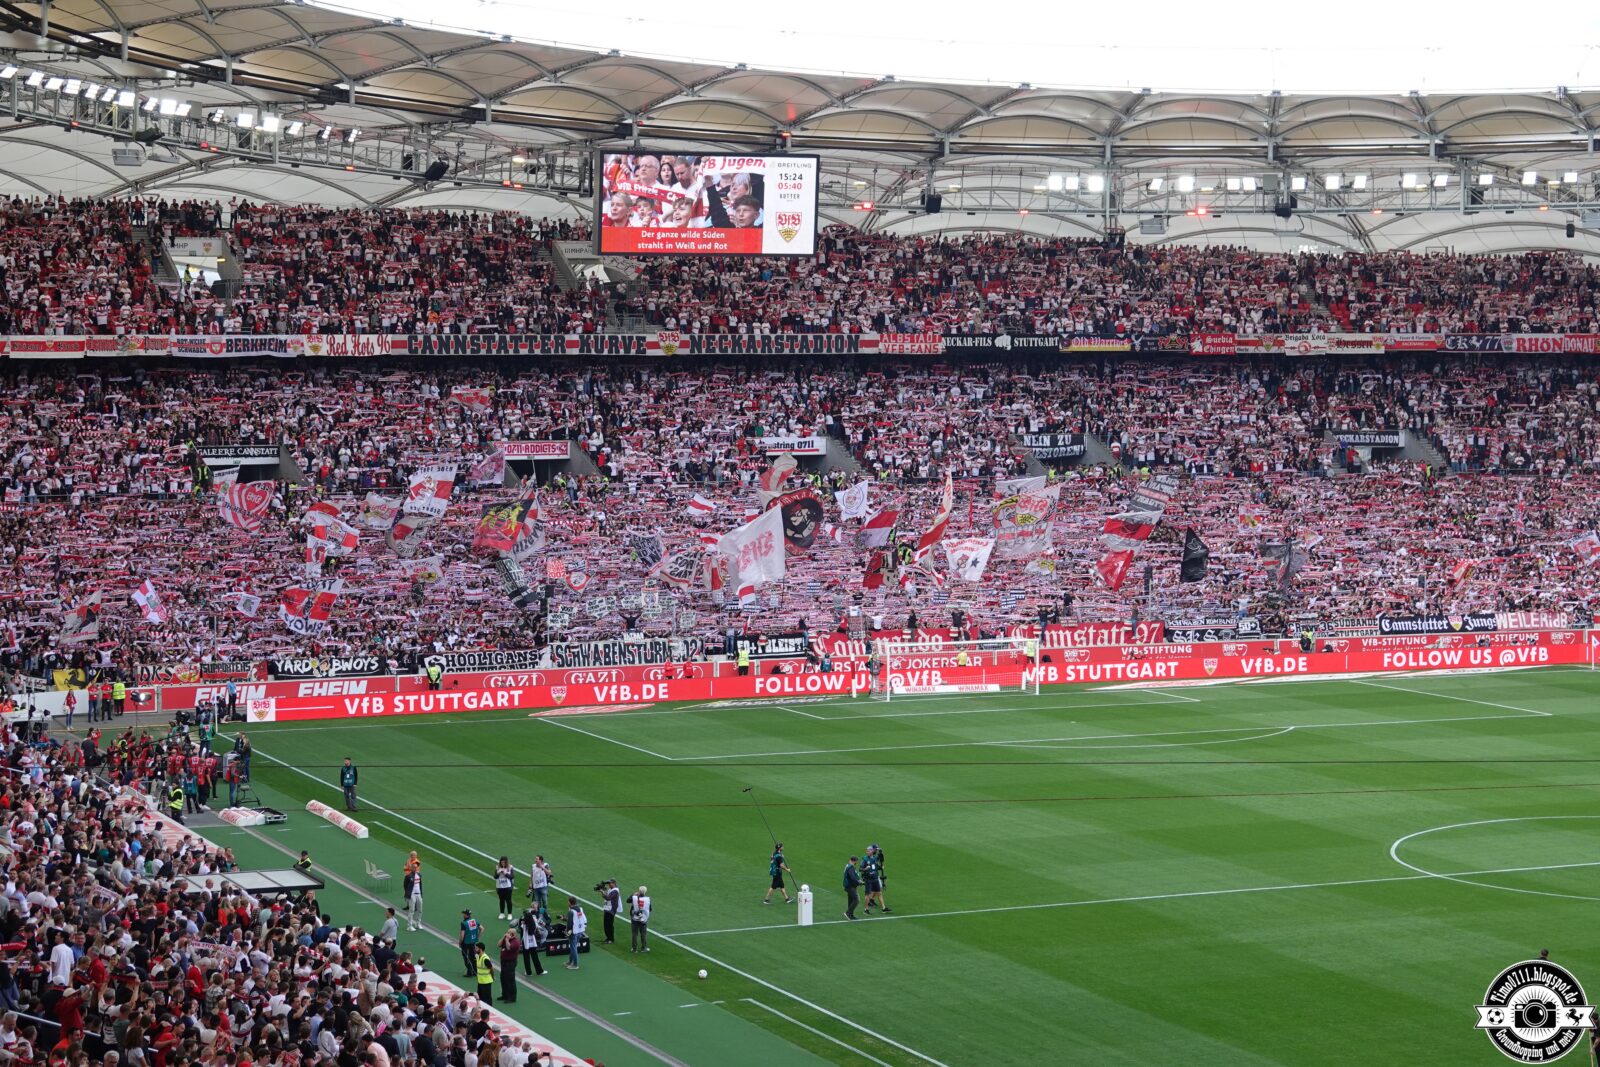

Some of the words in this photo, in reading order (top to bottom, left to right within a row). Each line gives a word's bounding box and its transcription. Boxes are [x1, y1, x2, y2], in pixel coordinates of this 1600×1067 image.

[779, 173, 803, 181] 15:24
[778, 182, 802, 190] 05:40
[641, 230, 654, 239] Der
[656, 232, 678, 240] ganze
[681, 230, 700, 239] wilde
[702, 230, 725, 239] Süden
[637, 241, 663, 250] strahlt
[665, 242, 673, 250] in
[675, 241, 695, 250] Weiß
[698, 241, 712, 250] und
[714, 242, 727, 250] Rot
[225, 337, 288, 353] BERKHEIM
[326, 334, 348, 356] Red
[352, 335, 374, 356] Hots
[377, 334, 391, 354] 96
[407, 334, 566, 355] CANNSTATTER
[579, 334, 647, 355] KURVE
[690, 334, 860, 354] NECKARSTADION
[881, 334, 940, 343] ALBSTADT
[942, 337, 992, 347] NECKAR-FILS
[1013, 337, 1059, 347] STUTTGART
[1071, 337, 1087, 348] Old
[1205, 335, 1233, 344] Suebia
[1485, 336, 1501, 349] 77
[1564, 336, 1595, 352] DONAU
[884, 343, 939, 353] VFB-FANS
[797, 440, 814, 449] 0711
[1023, 435, 1050, 447] NEIN
[1058, 434, 1072, 445] ZU
[237, 446, 278, 456] CANNSTATT
[507, 444, 521, 454] 0711
[525, 443, 556, 453] ADDICTS
[1239, 621, 1260, 631] 50+1
[1320, 621, 1334, 631] 36
[1382, 615, 1449, 632] Cannstatter
[1463, 615, 1497, 631] Jungs
[1133, 623, 1161, 645] 97
[1291, 640, 1299, 648] 36
[1361, 636, 1427, 646] VfB-STIFTUNG
[444, 649, 539, 668] HOOLIGANS
[907, 656, 982, 669] JOKERSAR
[1383, 650, 1462, 668] FOLLOW
[1469, 649, 1492, 665] US
[1499, 647, 1549, 665] @VfB
[275, 658, 312, 673] YARD
[332, 656, 379, 671] BWOYS
[1066, 661, 1179, 681] STUTTGART
[1240, 657, 1308, 674] VfB.DE
[755, 674, 845, 693] FOLLOW
[888, 670, 942, 688] @VfB
[958, 684, 988, 692] WINAMAX
[298, 680, 367, 697] EHEIM
[594, 683, 669, 702] VfB.DE
[905, 685, 936, 693] WINAMAX
[344, 697, 385, 714] VfB
[393, 689, 523, 715] STUTTGART
